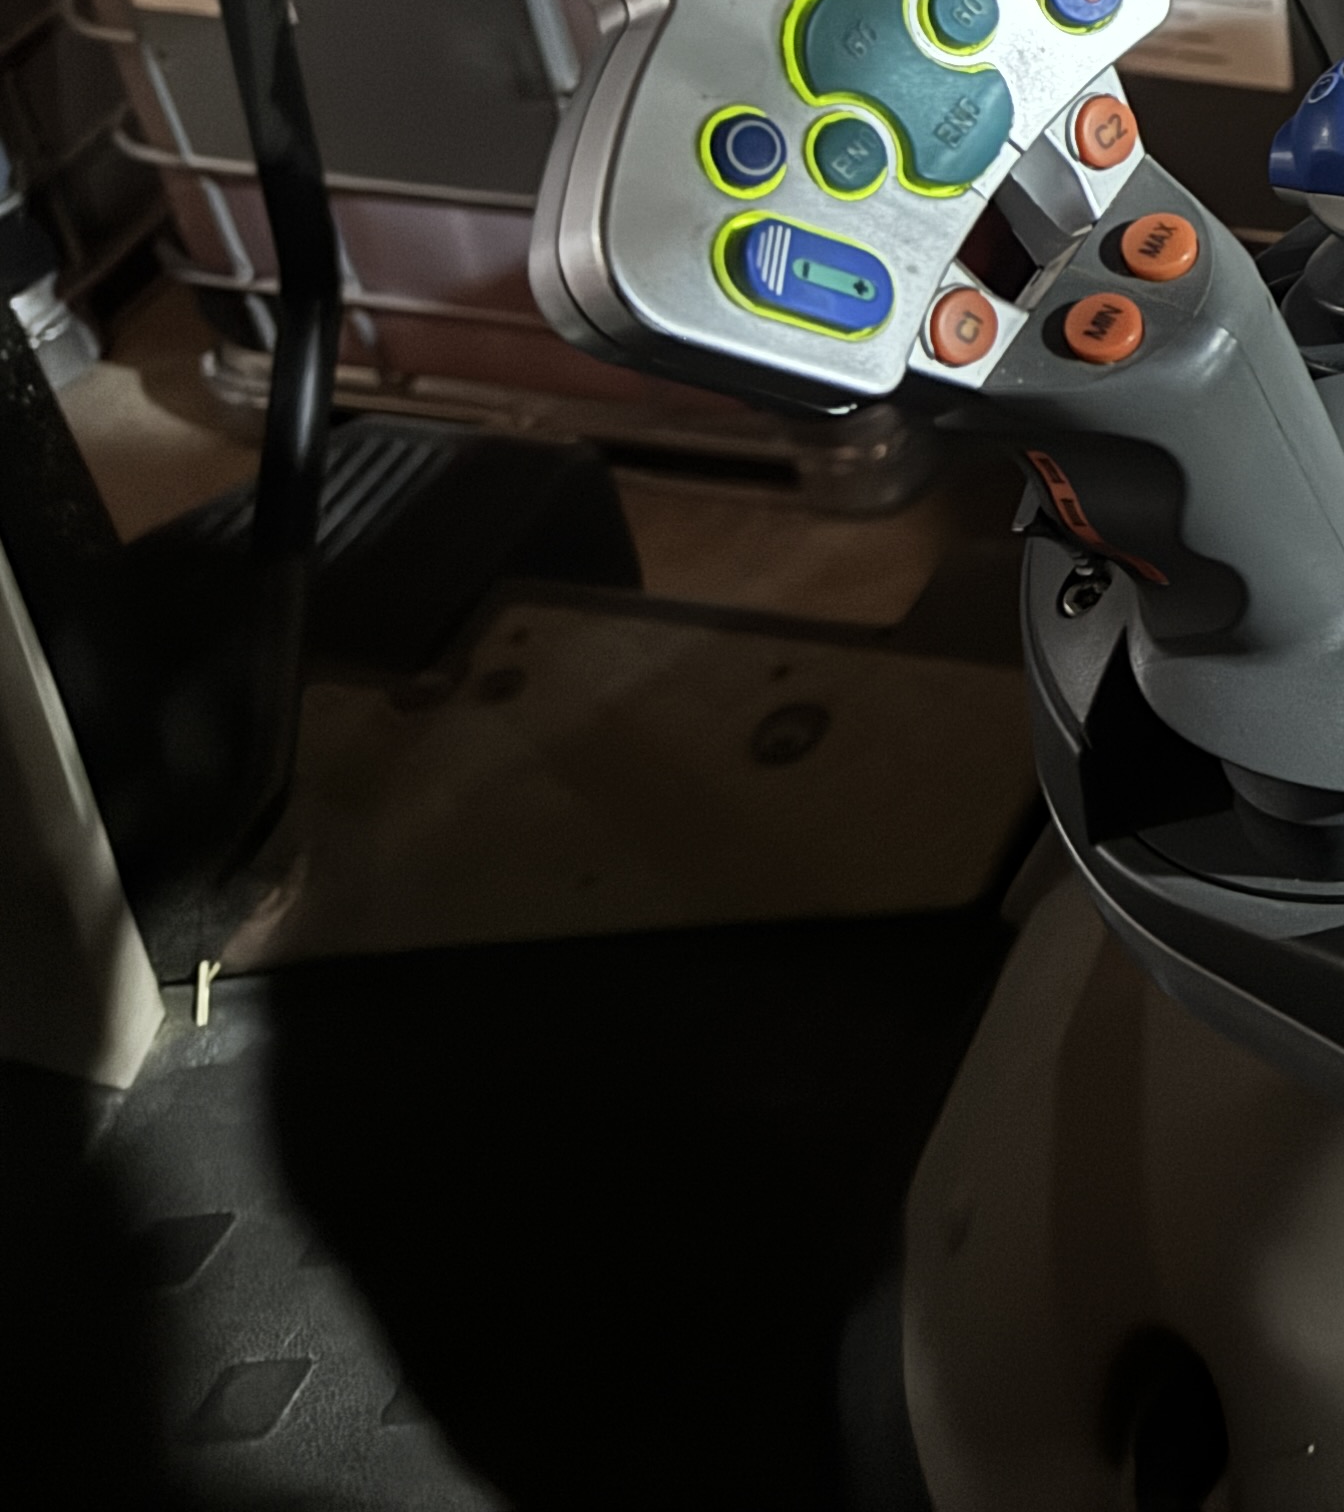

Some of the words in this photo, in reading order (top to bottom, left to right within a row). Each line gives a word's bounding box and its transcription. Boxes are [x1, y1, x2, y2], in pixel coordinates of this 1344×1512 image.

[1094, 114, 1126, 149] C2
[1137, 222, 1178, 258] MAX
[954, 310, 982, 344] C1
[1083, 303, 1122, 340] MIN
